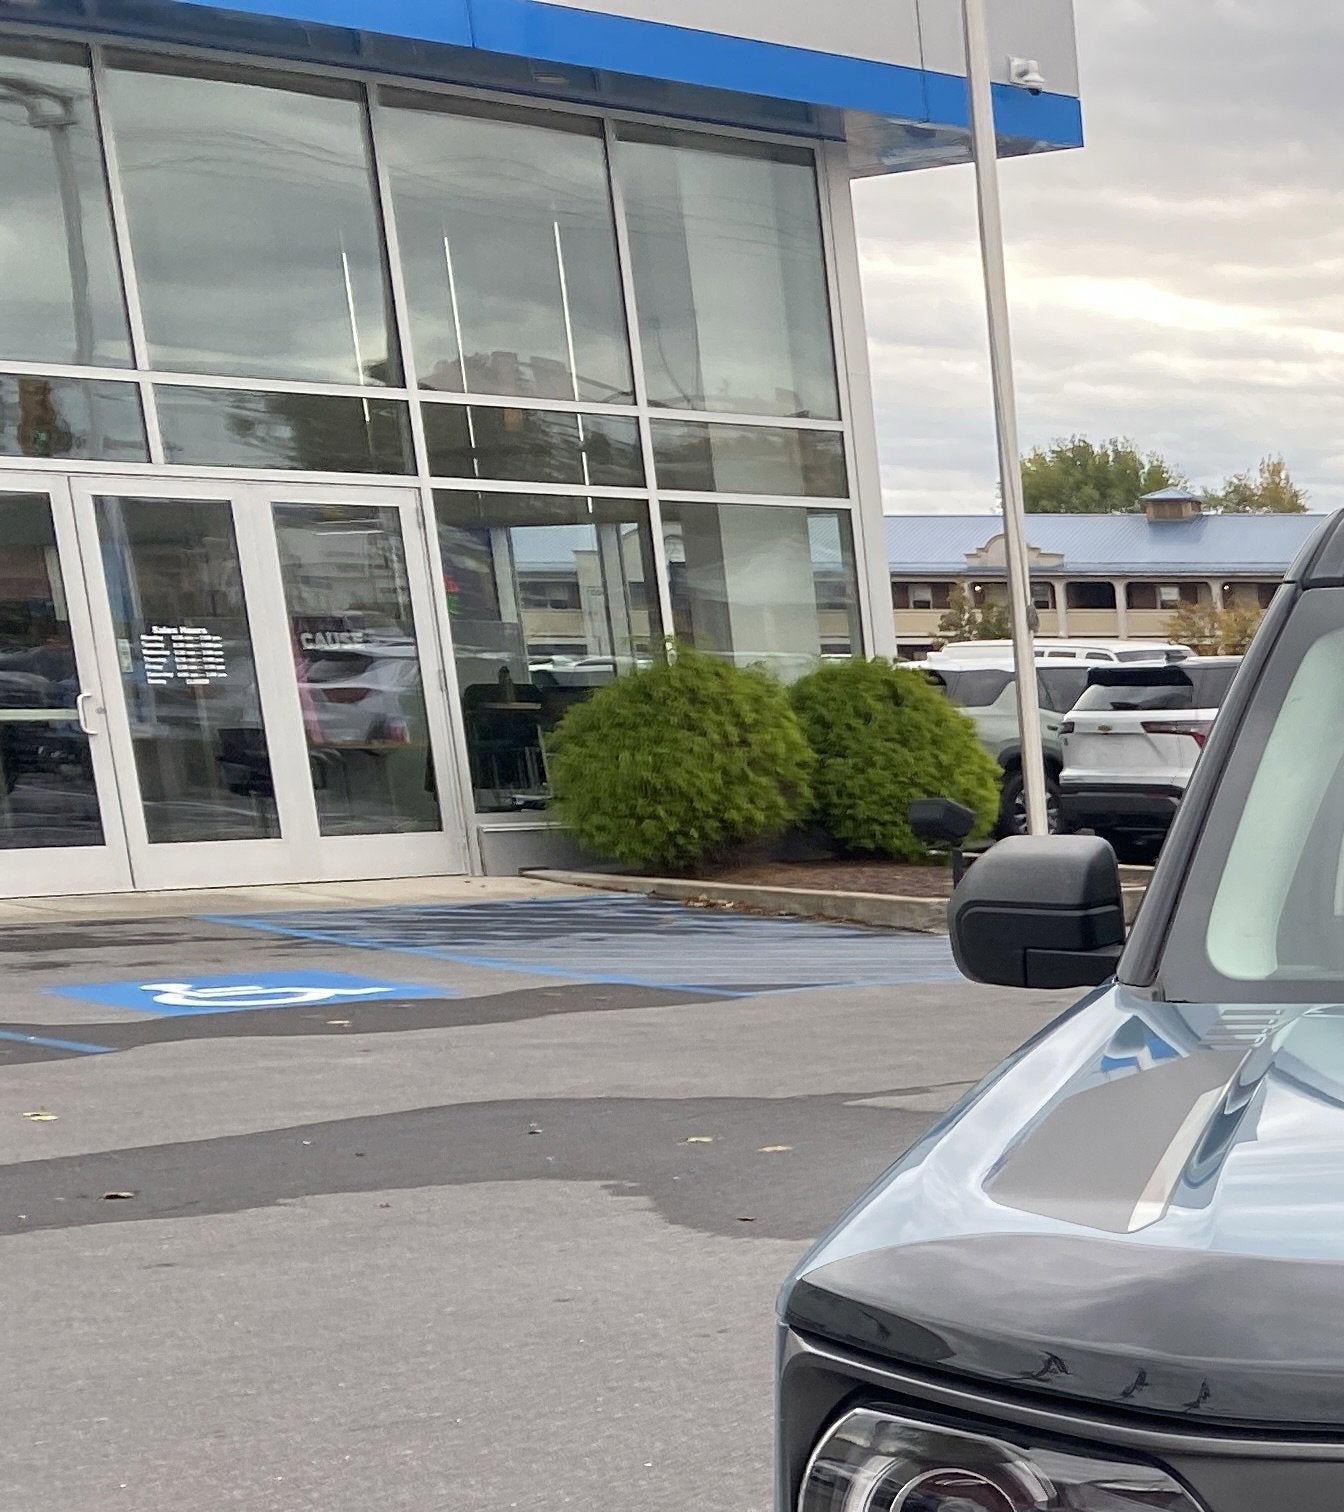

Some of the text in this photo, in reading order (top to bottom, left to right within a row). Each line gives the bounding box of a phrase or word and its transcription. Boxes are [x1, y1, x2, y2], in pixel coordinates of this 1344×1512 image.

[151, 625, 208, 634] Sales Hours
[300, 632, 364, 648] CAUSE
